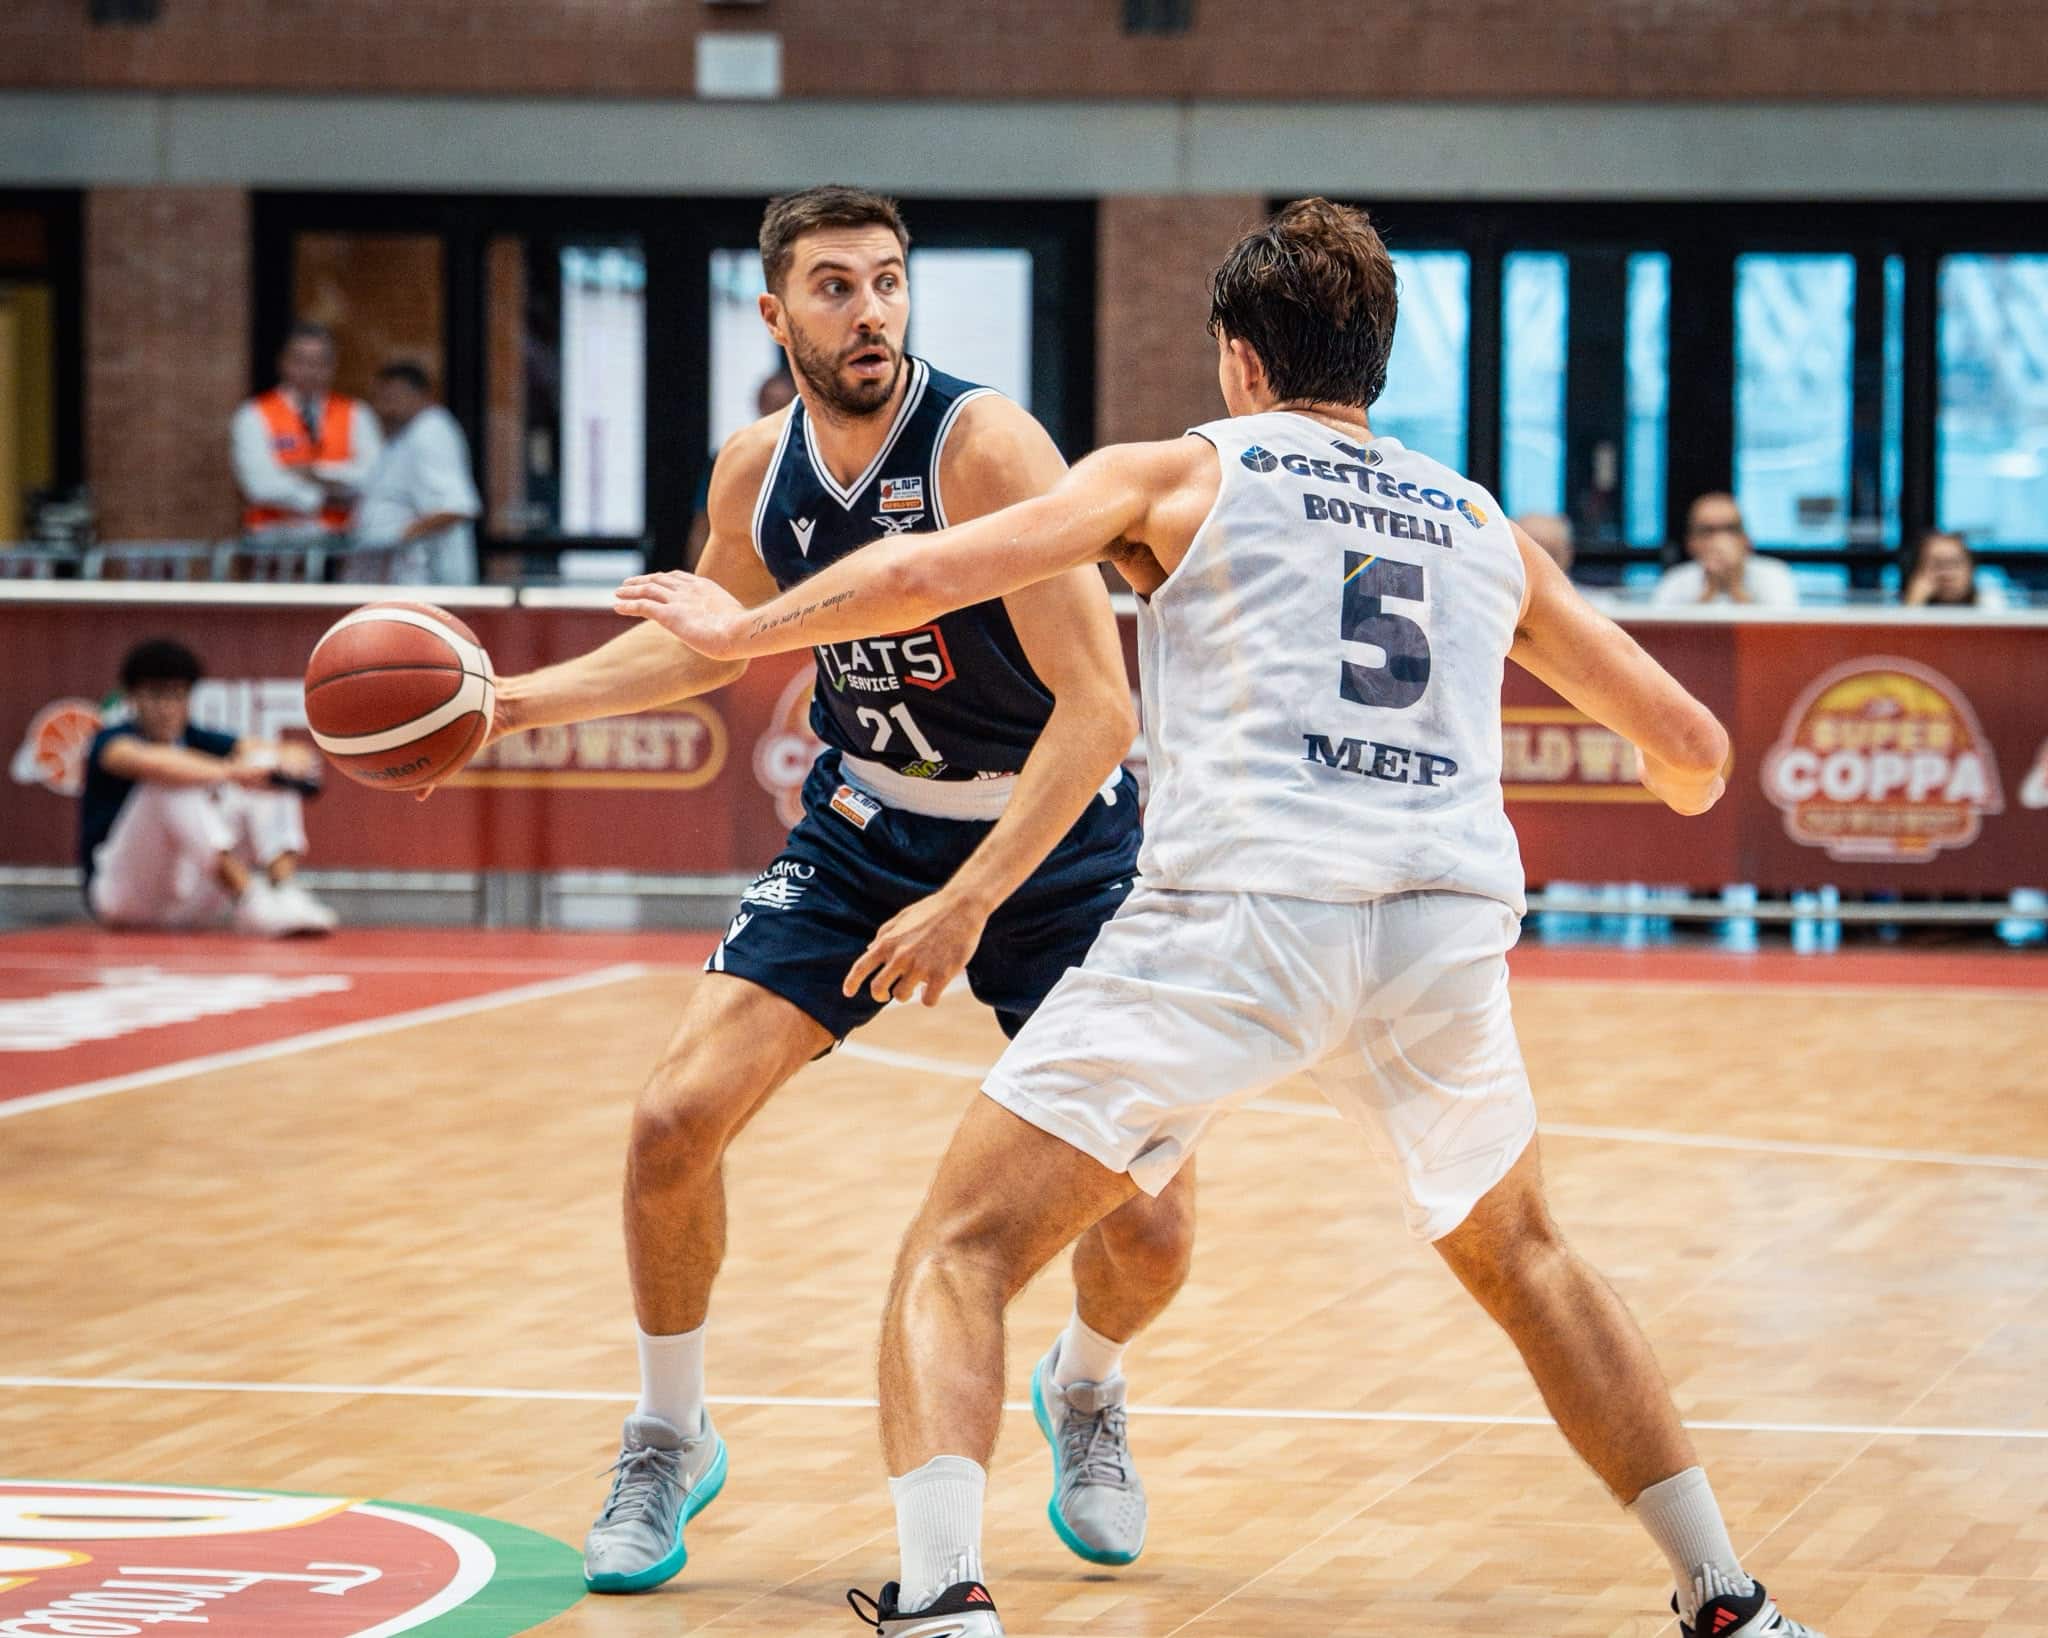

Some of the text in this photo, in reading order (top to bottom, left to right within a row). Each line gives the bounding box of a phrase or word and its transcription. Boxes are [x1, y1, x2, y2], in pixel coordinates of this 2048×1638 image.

[891, 479, 921, 491] LNP
[1281, 453, 1455, 512] GESTECO
[1303, 493, 1453, 549] BOTTELLI
[1340, 550, 1431, 710] 5
[846, 675, 900, 693] SERVICE
[856, 702, 943, 763] 21
[1811, 717, 1952, 750] SUPER
[1302, 734, 1459, 788] MEP
[1777, 750, 1985, 801] COPPA
